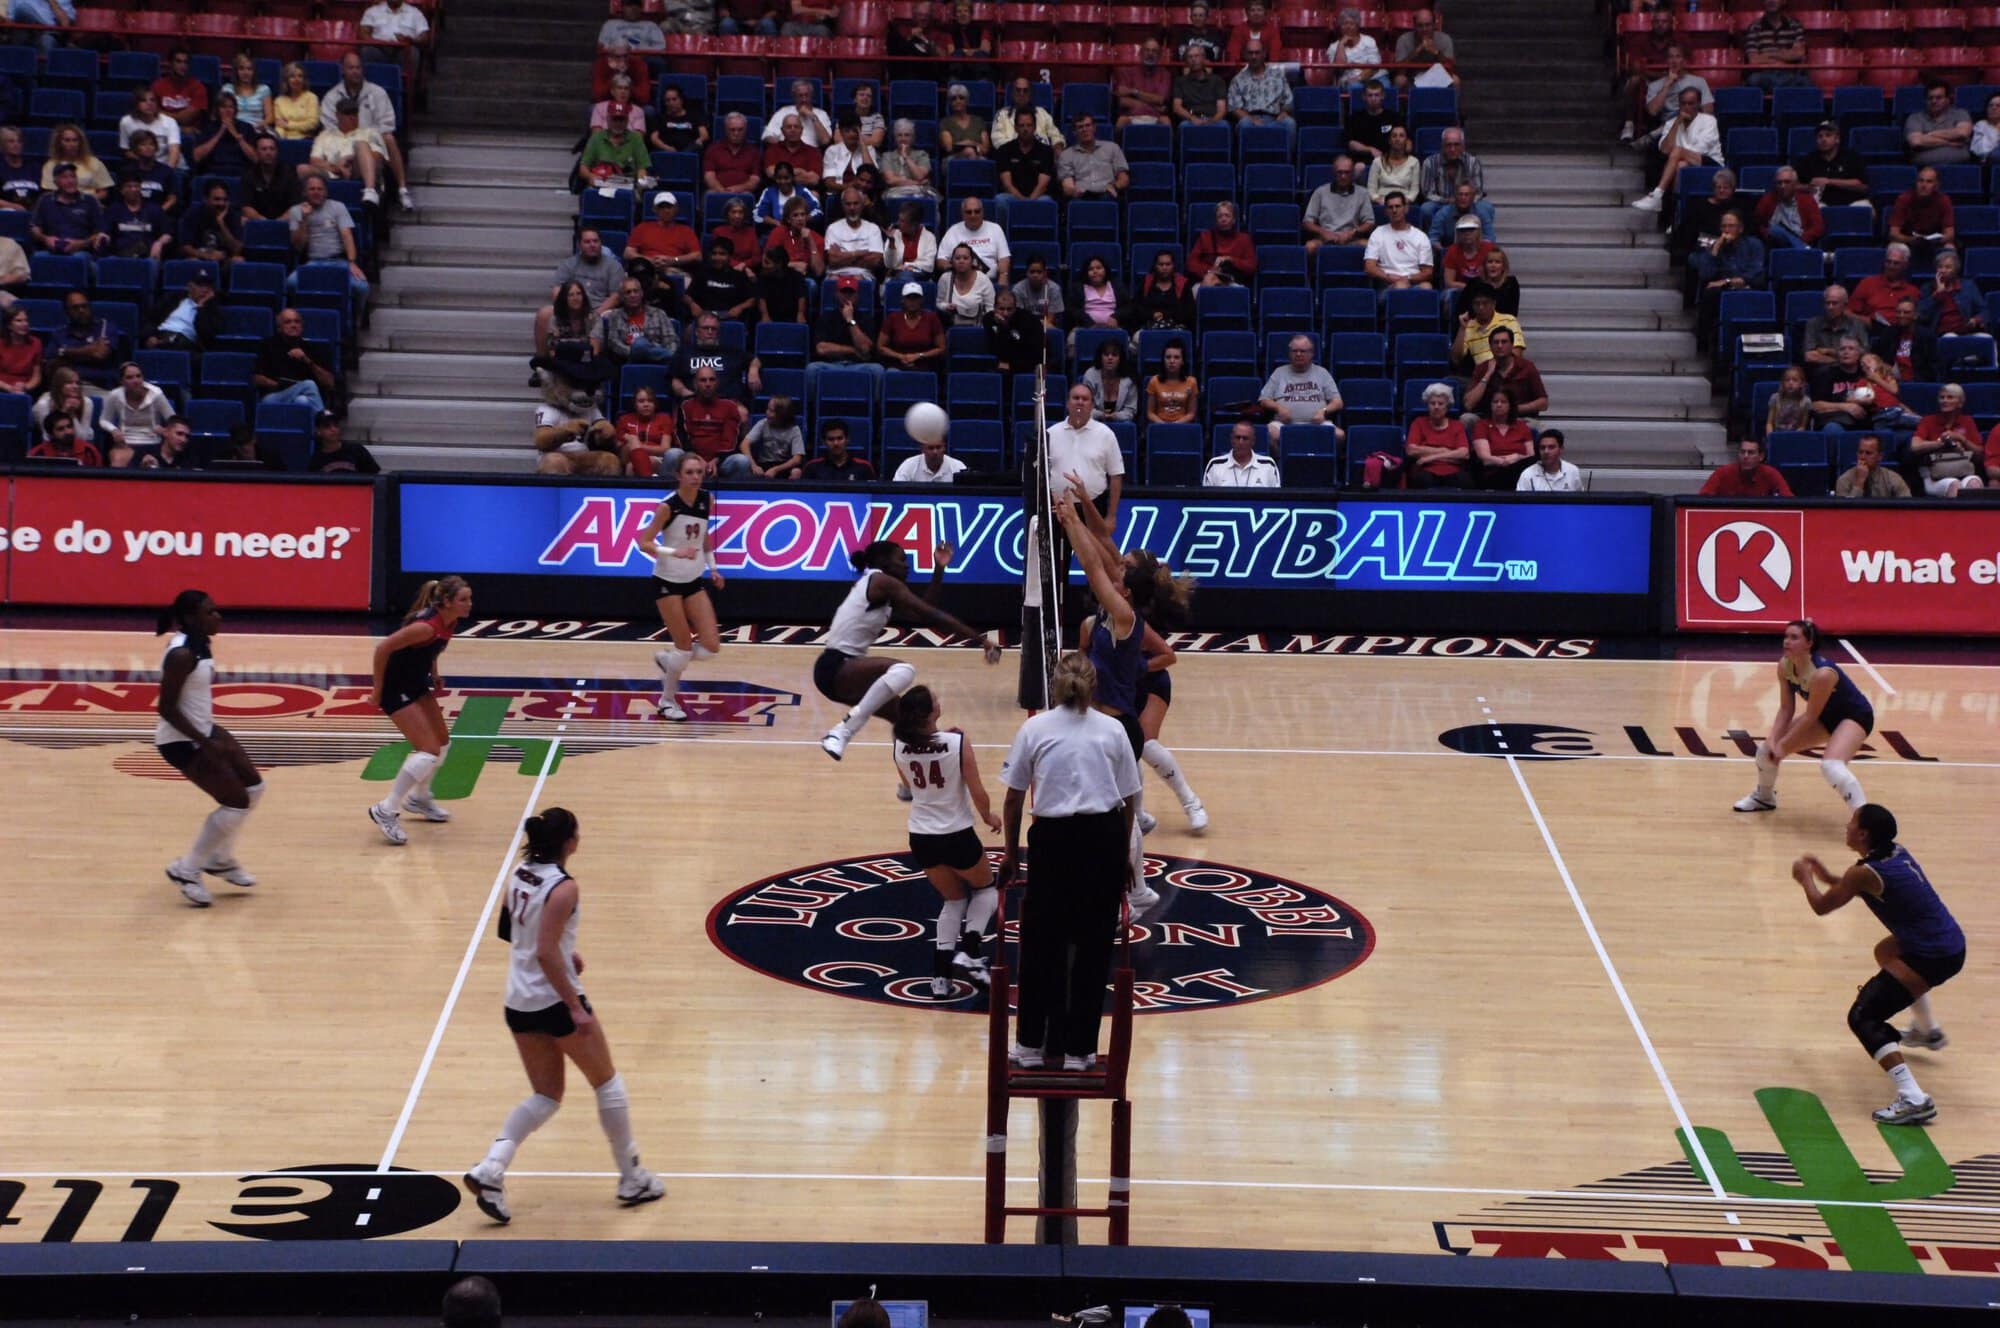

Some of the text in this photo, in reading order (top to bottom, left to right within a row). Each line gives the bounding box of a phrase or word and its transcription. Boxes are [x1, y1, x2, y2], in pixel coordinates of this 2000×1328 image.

[690, 357, 724, 369] UMC
[54, 519, 112, 554] do
[123, 529, 203, 563] you
[214, 526, 350, 560] need?
[538, 497, 937, 571] ARZONA
[935, 502, 1503, 582] VLEYBALL
[685, 523, 701, 540] 99
[1840, 550, 1957, 584] What
[452, 619, 629, 641] 1997
[1164, 631, 1600, 658] HAMPIONS
[909, 760, 946, 790] 34
[727, 858, 929, 929] LUTE
[803, 961, 1270, 1010] CORT
